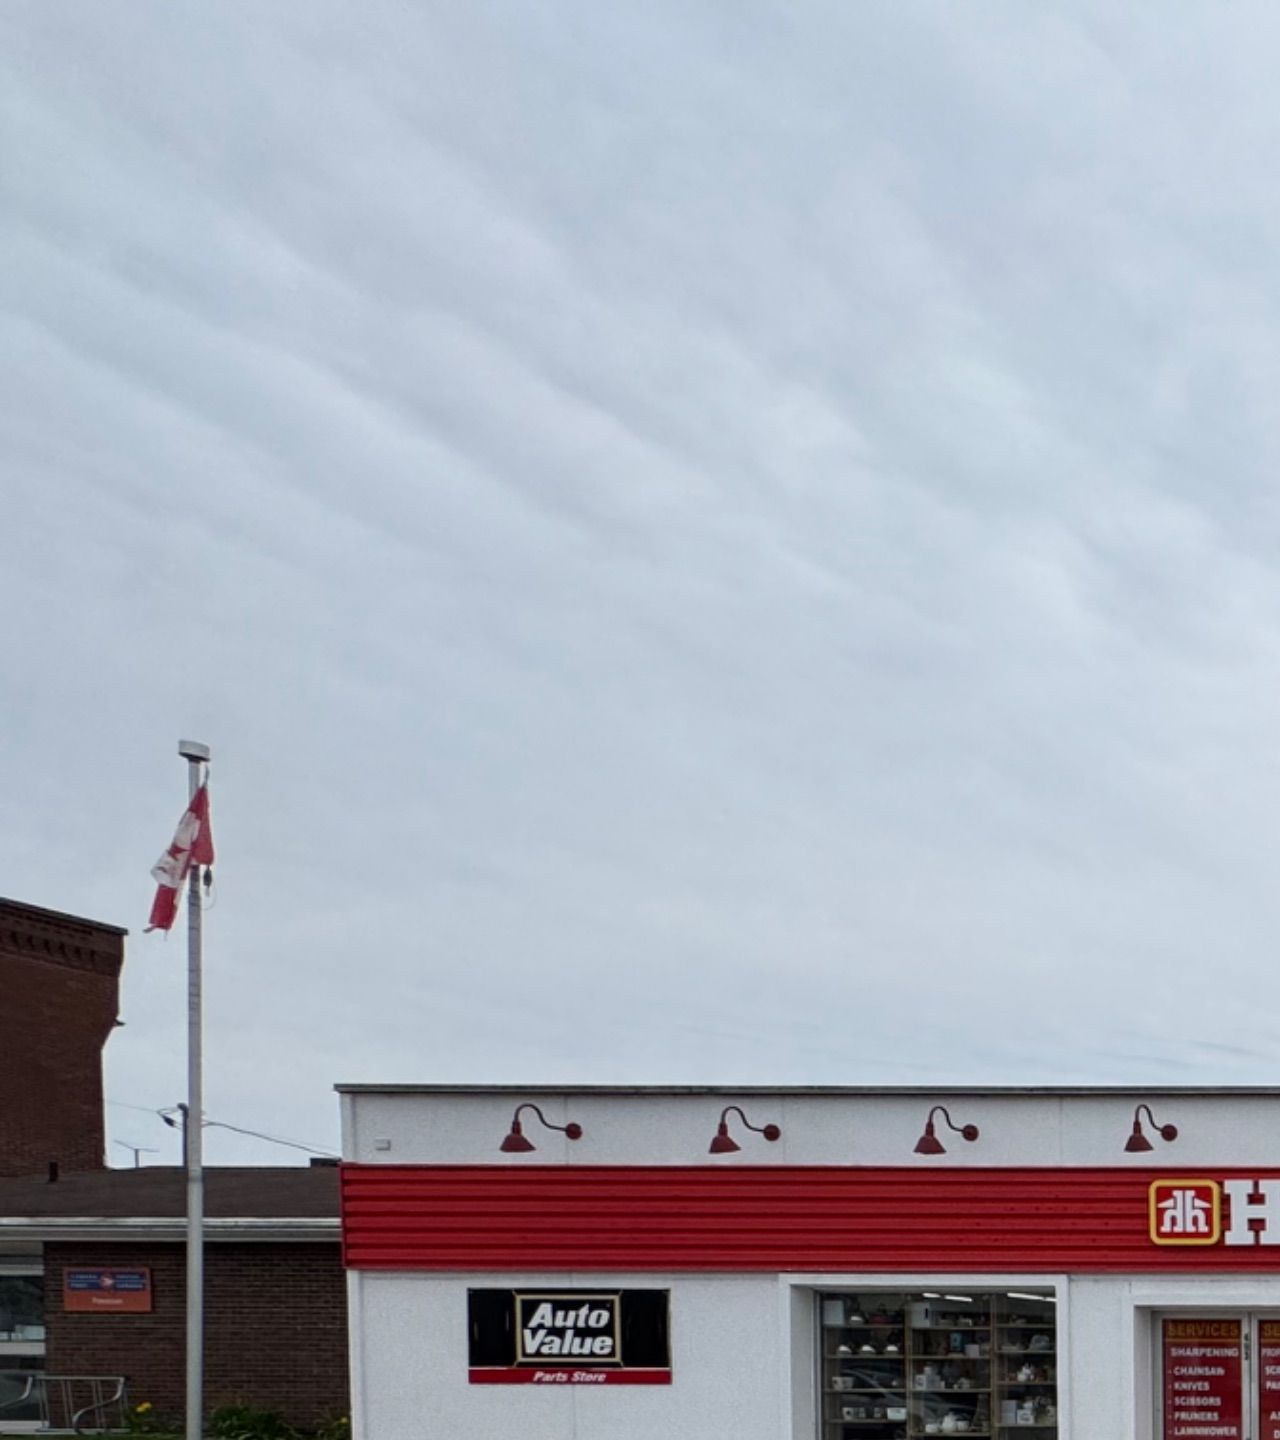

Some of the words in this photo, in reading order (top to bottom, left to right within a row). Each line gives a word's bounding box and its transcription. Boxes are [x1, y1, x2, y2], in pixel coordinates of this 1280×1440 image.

[527, 1302, 610, 1328] Auto
[1168, 1323, 1239, 1336] SERVICES
[523, 1329, 614, 1355] Value
[1171, 1347, 1239, 1357] SHARPENING
[533, 1371, 568, 1382] Parts
[571, 1371, 606, 1382] Store
[1174, 1381, 1210, 1391] KNIVES
[1174, 1396, 1222, 1406] SCISSORS
